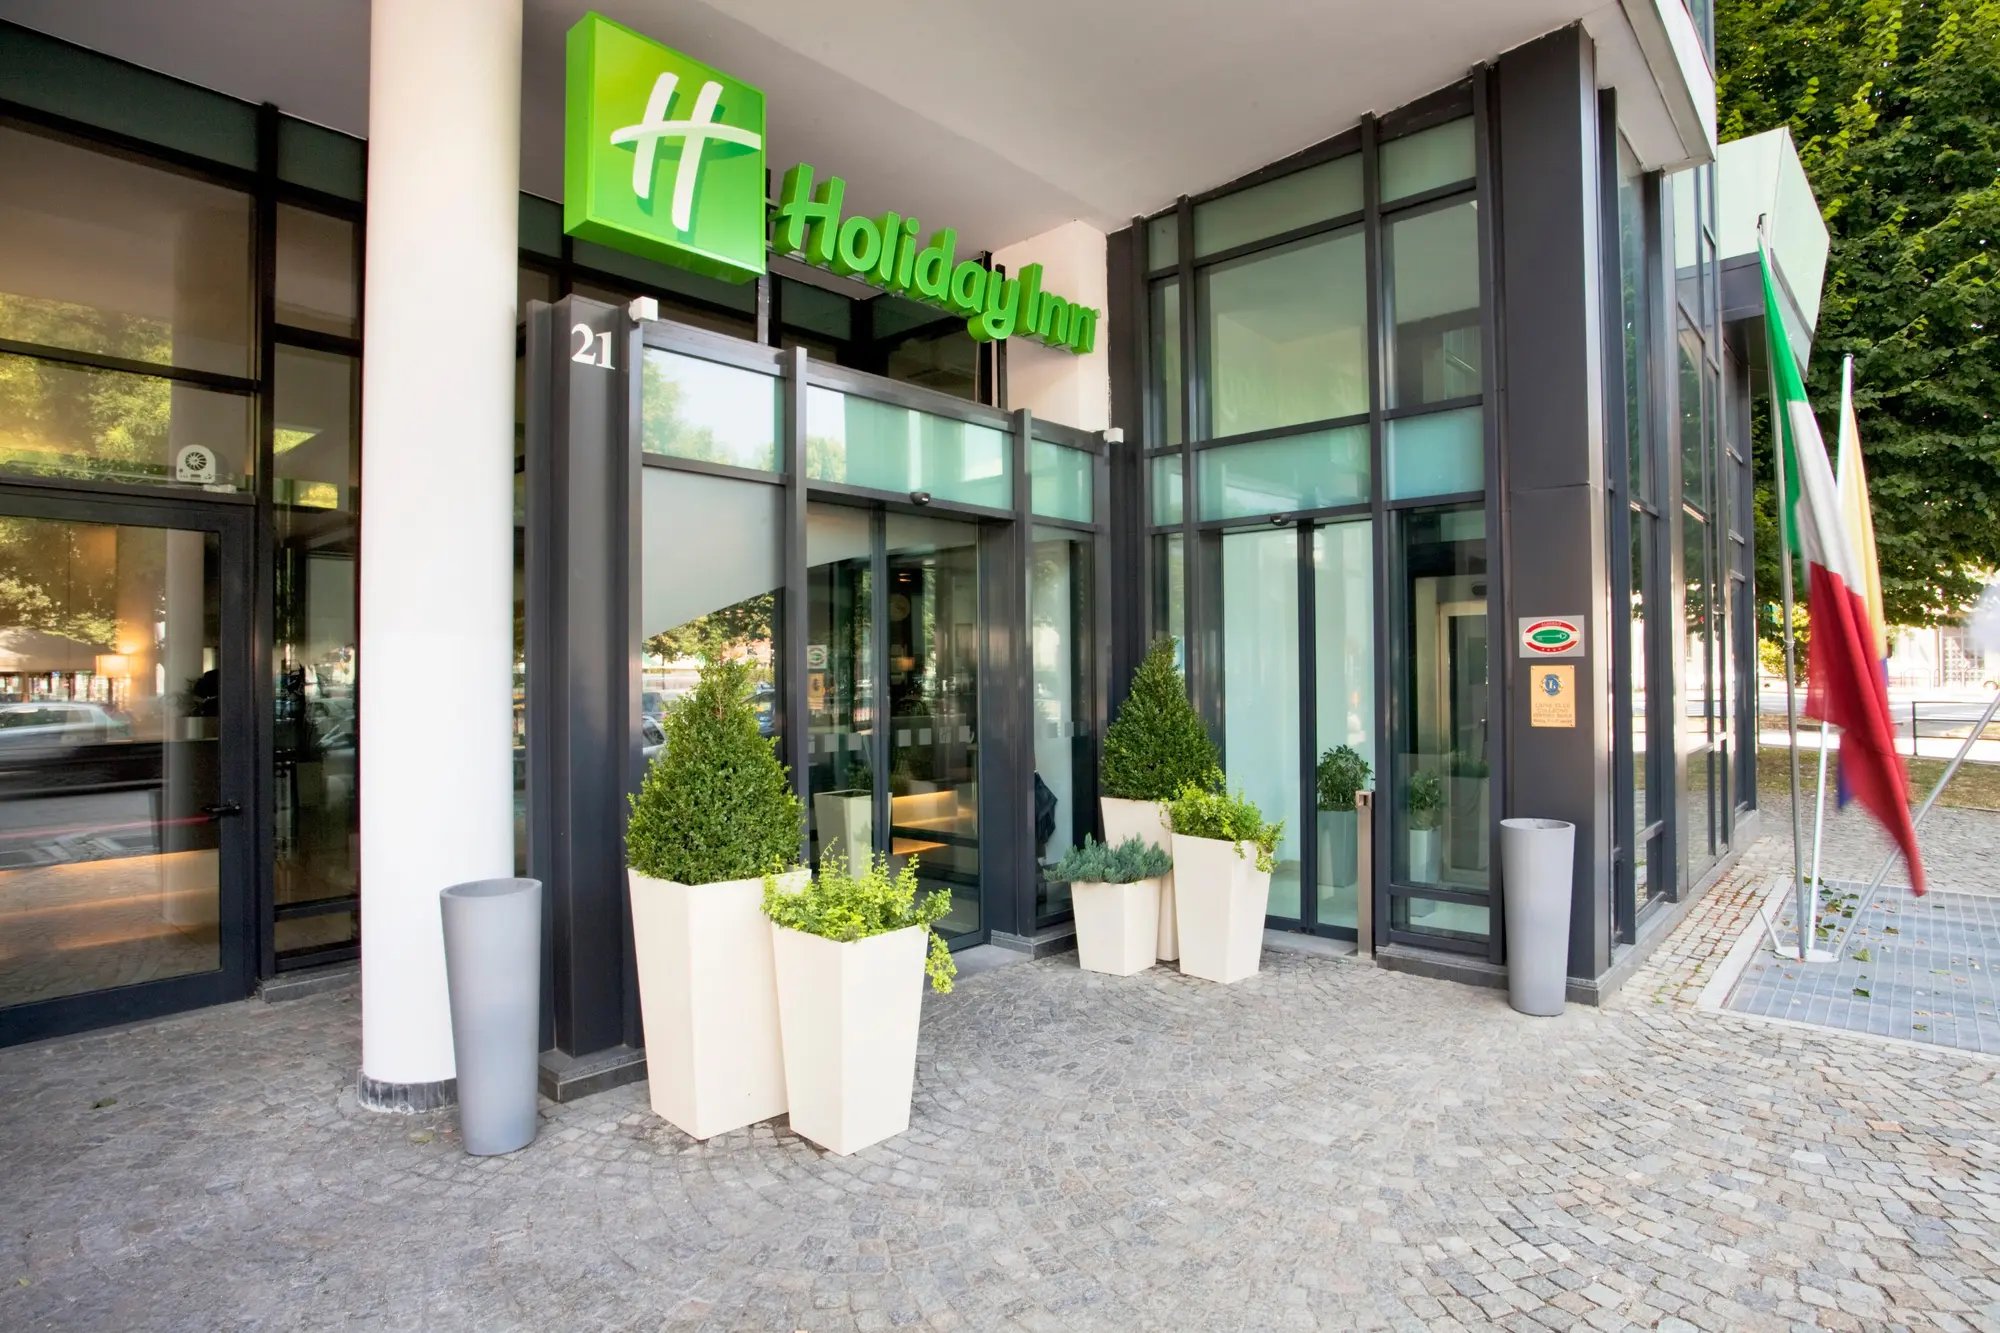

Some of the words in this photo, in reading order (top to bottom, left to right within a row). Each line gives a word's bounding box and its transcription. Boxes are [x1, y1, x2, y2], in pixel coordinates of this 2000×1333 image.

[610, 71, 762, 233] H
[772, 162, 1021, 341] Holiday
[1016, 262, 1098, 355] Inn
[571, 323, 616, 370] 21
